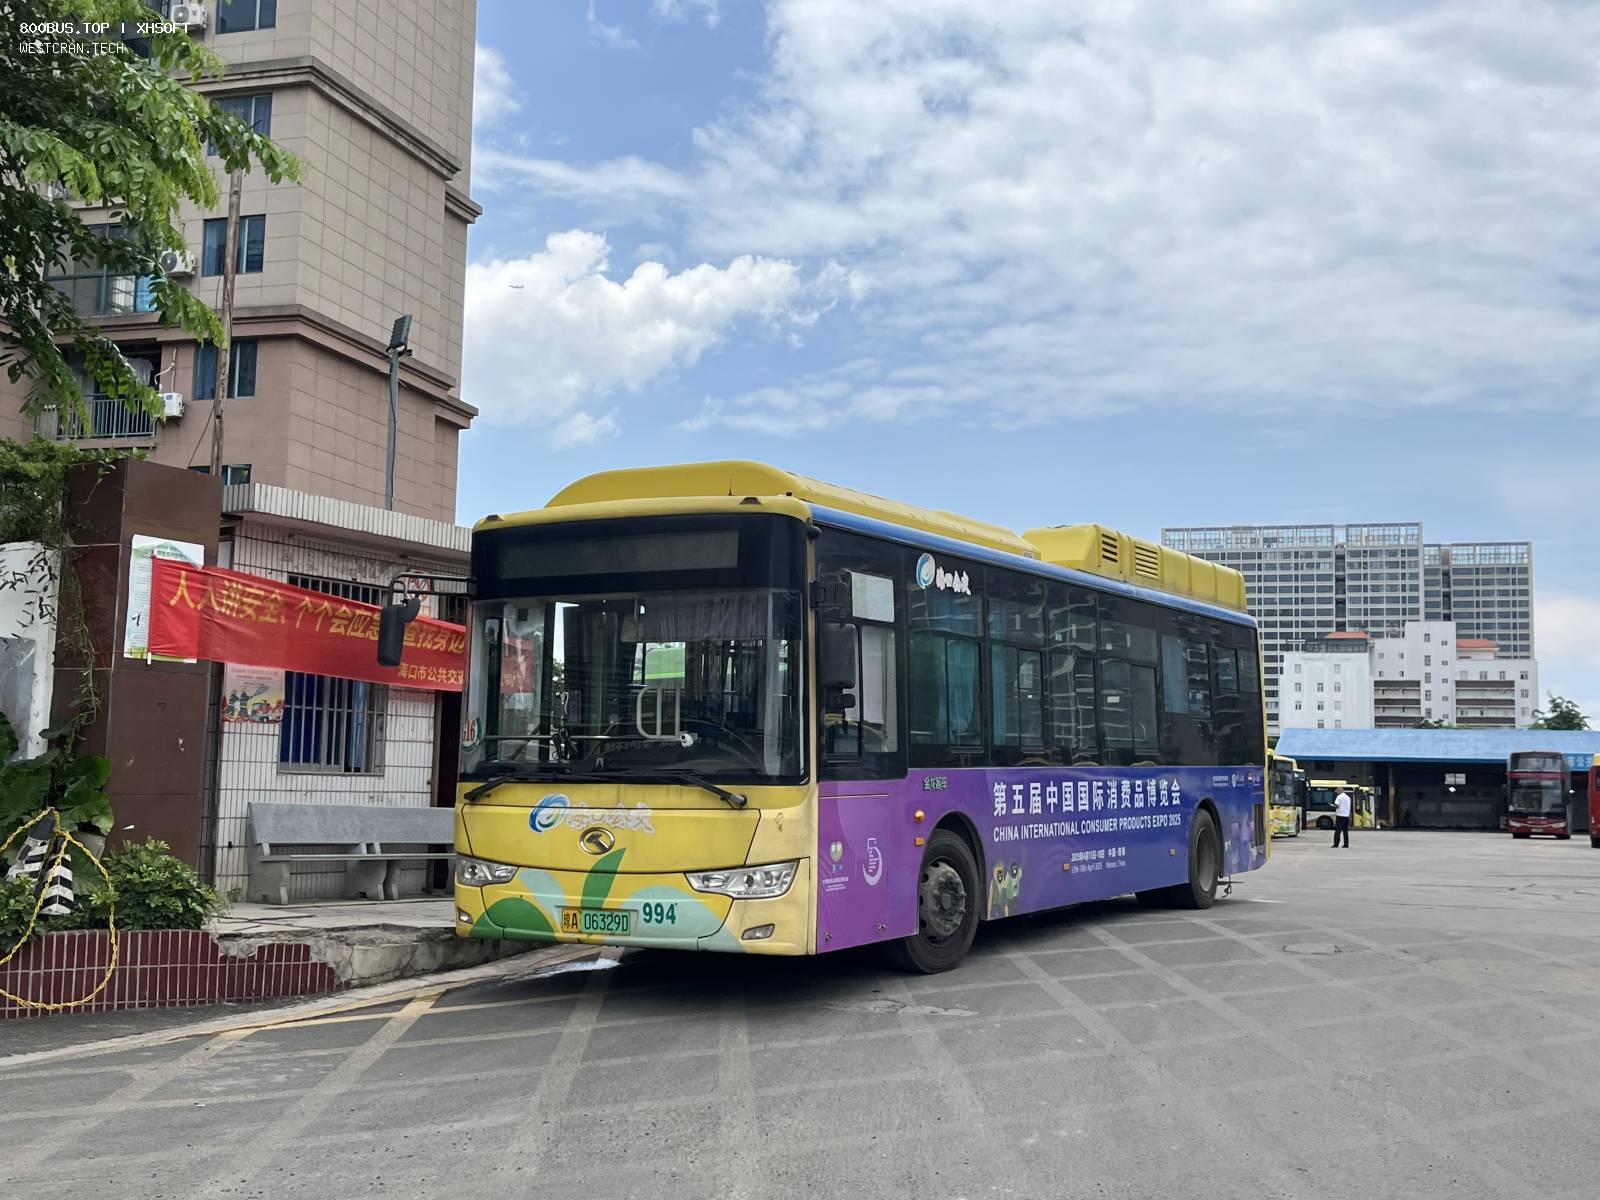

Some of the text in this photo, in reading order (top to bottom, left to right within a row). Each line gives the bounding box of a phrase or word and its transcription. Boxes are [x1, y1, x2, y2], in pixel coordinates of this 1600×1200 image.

[993, 778, 1182, 817] 第五届中国国际消费品博览会
[993, 813, 1182, 843] CHINA INTERNATIONAL CONSUMER PRODUCTS EXPO 2025
[642, 902, 678, 925] 994
